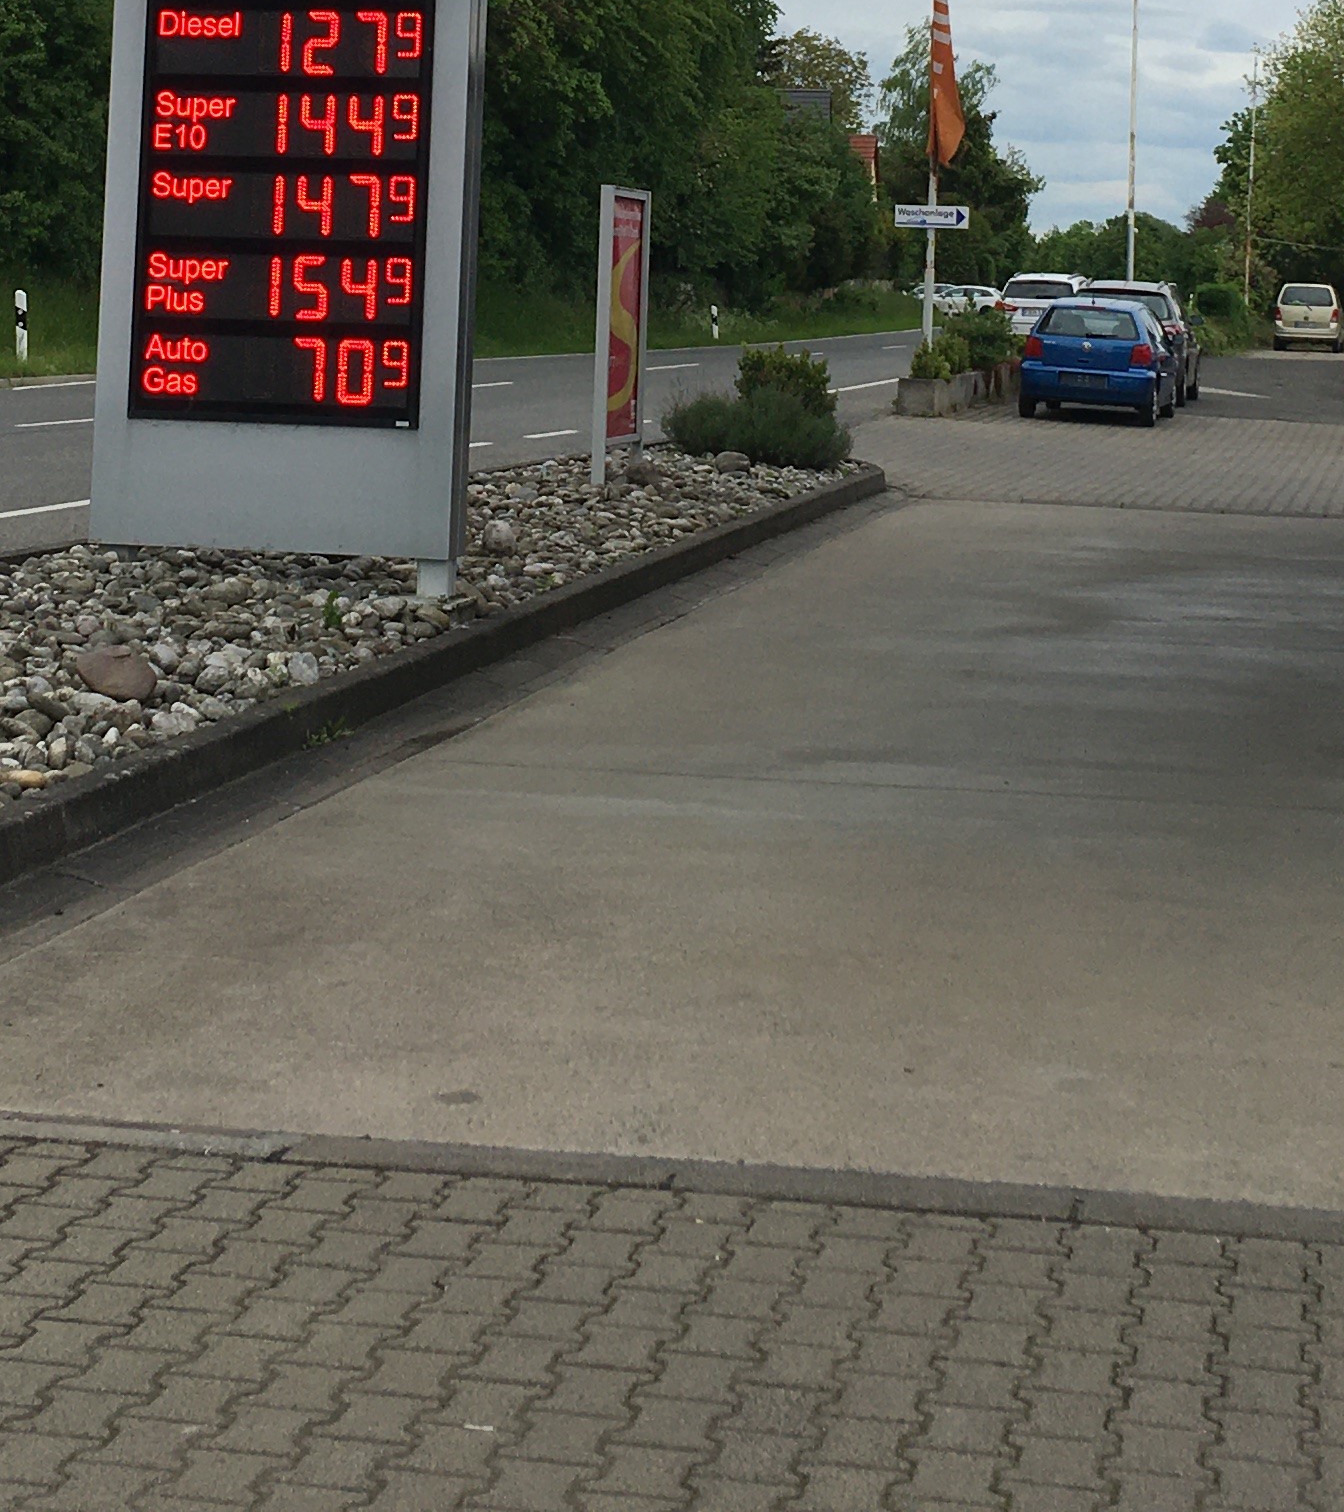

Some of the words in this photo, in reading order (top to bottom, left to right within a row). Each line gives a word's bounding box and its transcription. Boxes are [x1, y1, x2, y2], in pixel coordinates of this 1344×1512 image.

[159, 10, 242, 37] Diesel
[155, 91, 236, 125] Super
[153, 124, 207, 150] E10
[152, 172, 233, 204] Super
[897, 207, 955, 219] Waschanlage
[148, 252, 229, 285] Super
[145, 285, 204, 312] Plus
[144, 334, 208, 362] Auto
[142, 367, 198, 395] Gas
